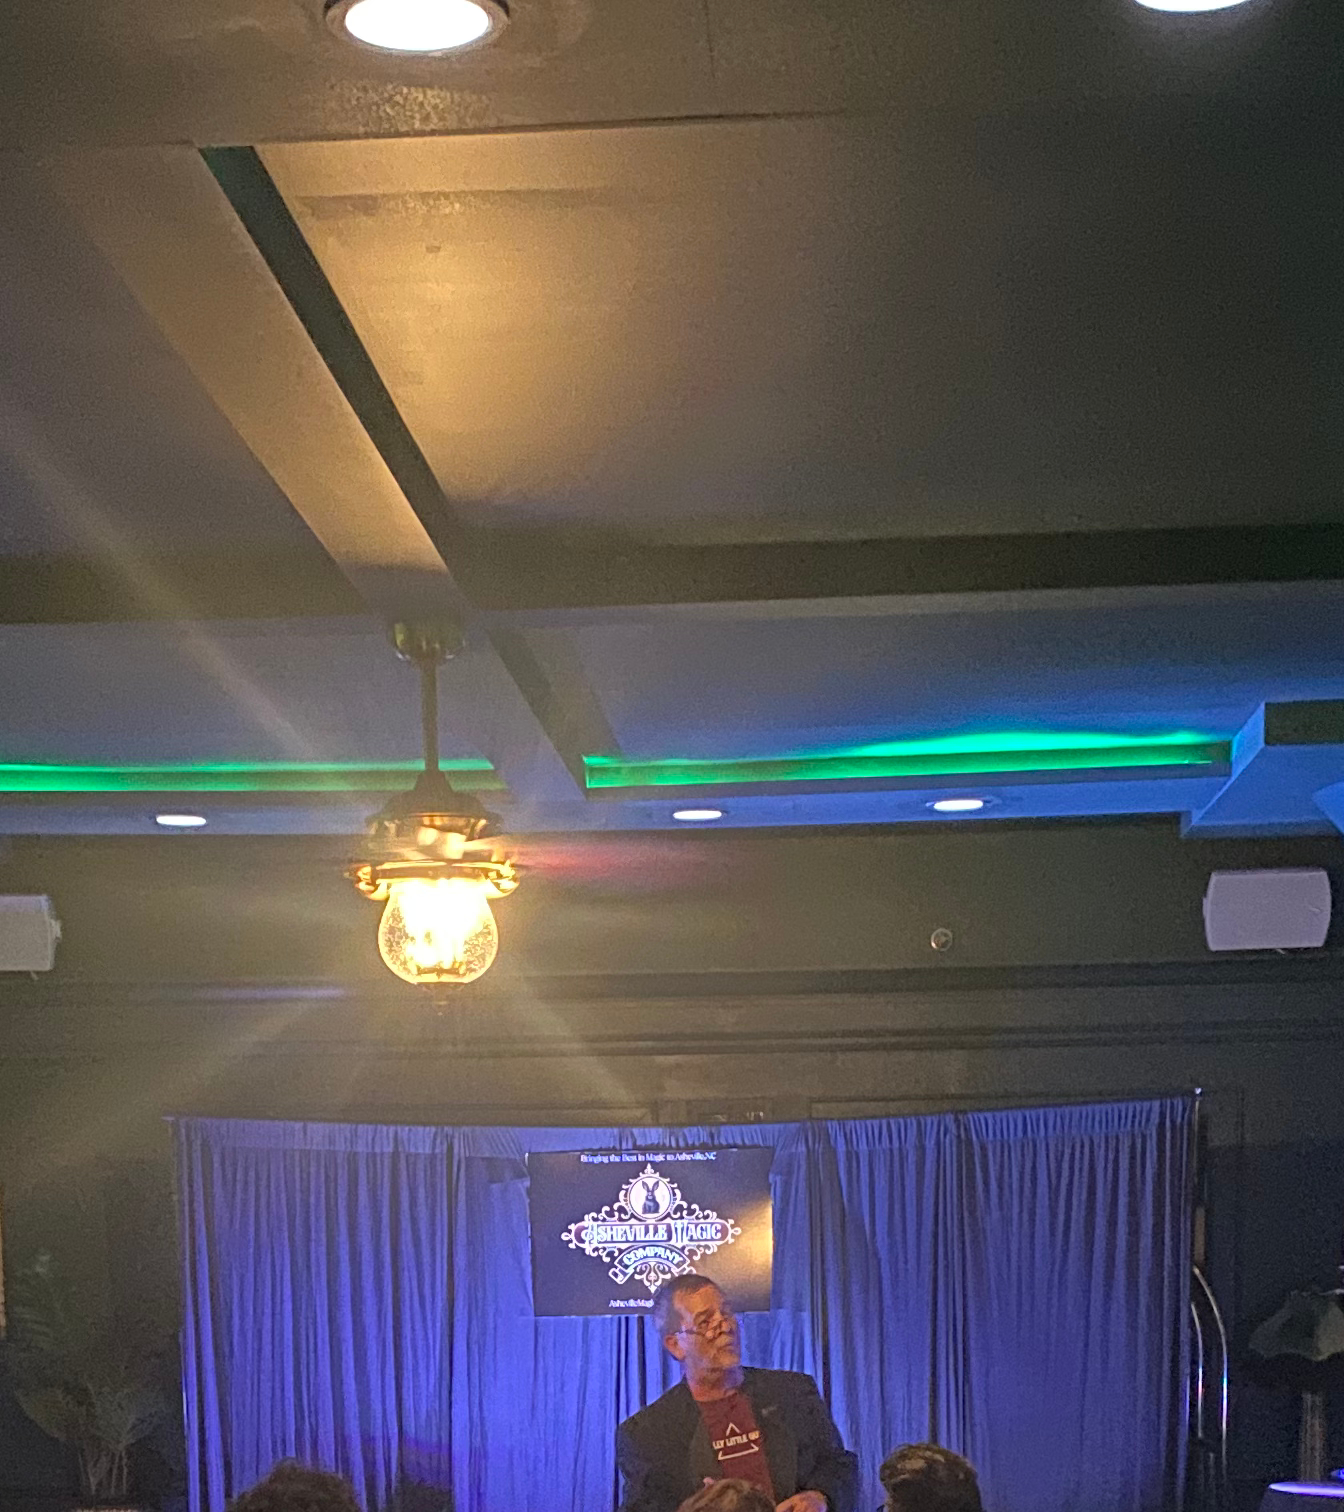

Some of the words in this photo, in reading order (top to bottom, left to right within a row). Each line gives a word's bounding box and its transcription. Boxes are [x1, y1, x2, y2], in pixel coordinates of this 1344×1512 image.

[610, 1154, 621, 1162] the
[646, 1153, 665, 1163] Magic
[581, 1221, 667, 1243] ASHEVILLE
[671, 1220, 722, 1243] MAGIC
[622, 1246, 684, 1265] COMPANY
